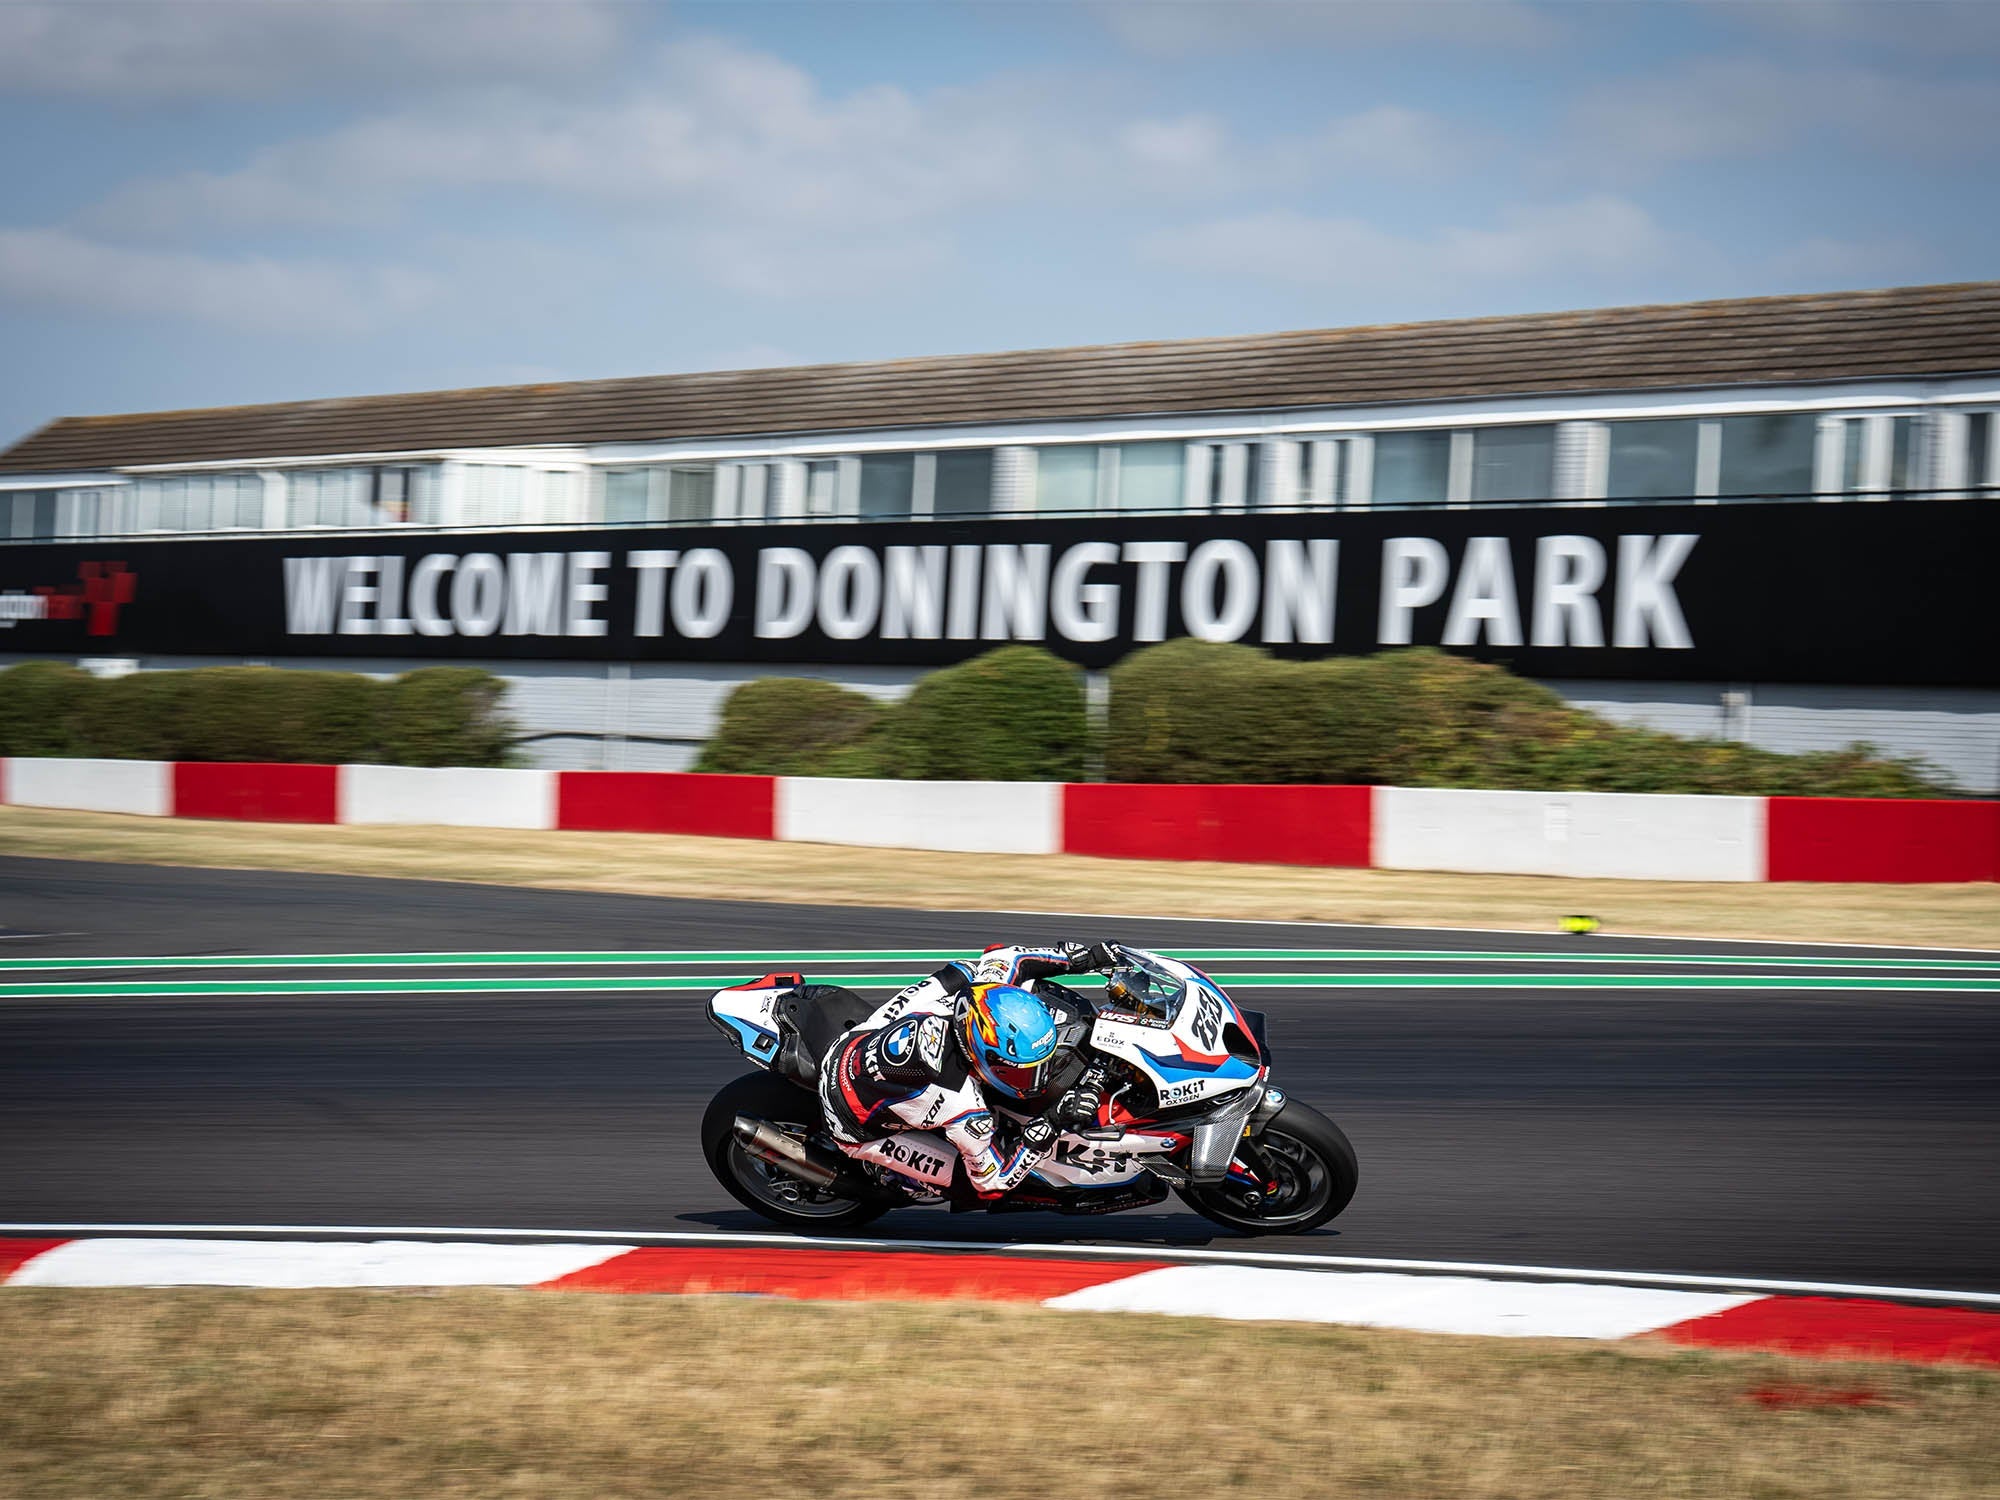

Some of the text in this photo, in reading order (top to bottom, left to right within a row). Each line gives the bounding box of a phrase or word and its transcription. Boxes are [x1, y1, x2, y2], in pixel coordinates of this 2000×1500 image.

[283, 532, 1701, 650] WELCOME TO DONINGTON PARK
[920, 1092, 946, 1129] XON
[1166, 1093, 1200, 1105] OXYGEN
